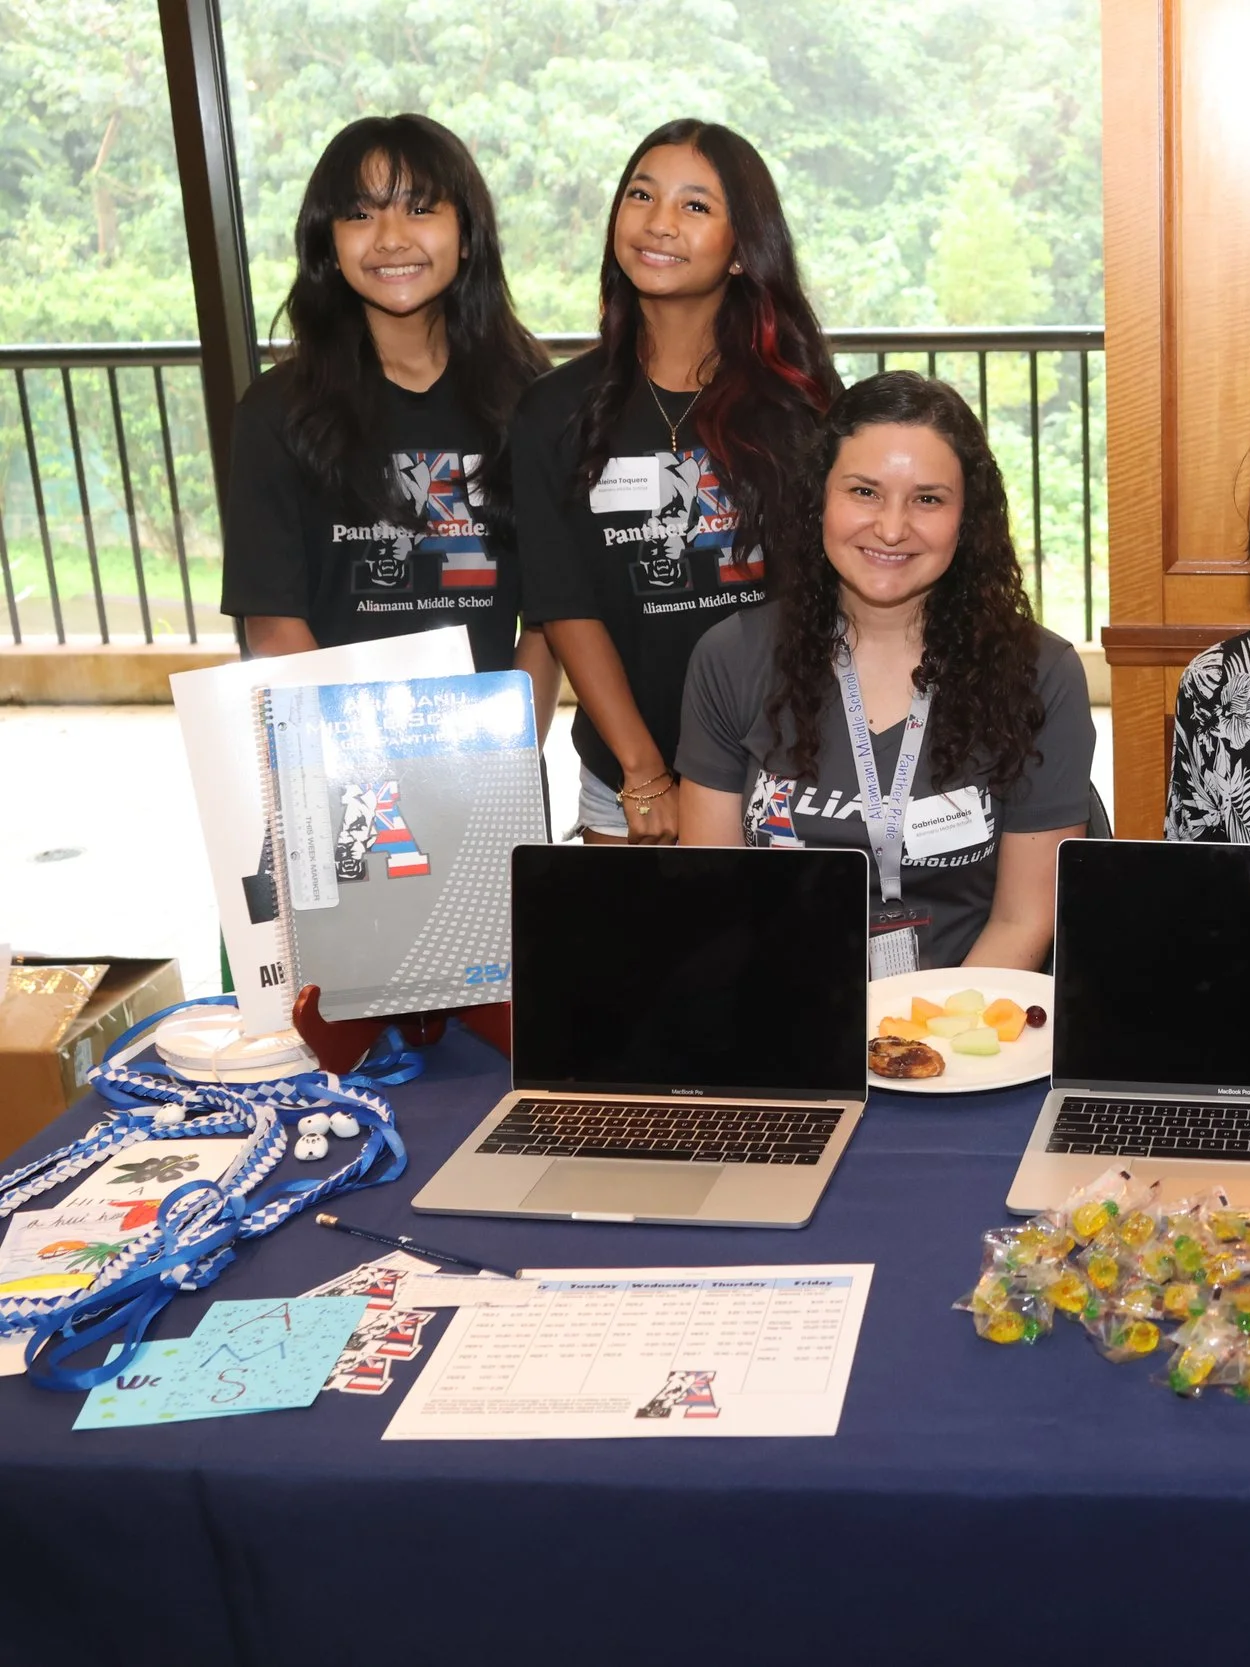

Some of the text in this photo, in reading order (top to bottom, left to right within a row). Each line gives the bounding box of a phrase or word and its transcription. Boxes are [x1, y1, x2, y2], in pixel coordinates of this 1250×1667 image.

[603, 519, 687, 546] Panther
[356, 595, 494, 612] Aliamanu Middle School
[643, 590, 766, 615] Aliamanu Middle Scho
[843, 672, 883, 820] Aliamanu Middle School
[885, 753, 915, 840] Panther Pride
[911, 808, 972, 830] Gabriela DuBois
[305, 816, 321, 902] THIS WEEK MARKER
[631, 1281, 700, 1289] Wednesday
[793, 1279, 834, 1287] Friday
[211, 1367, 249, 1404] S
